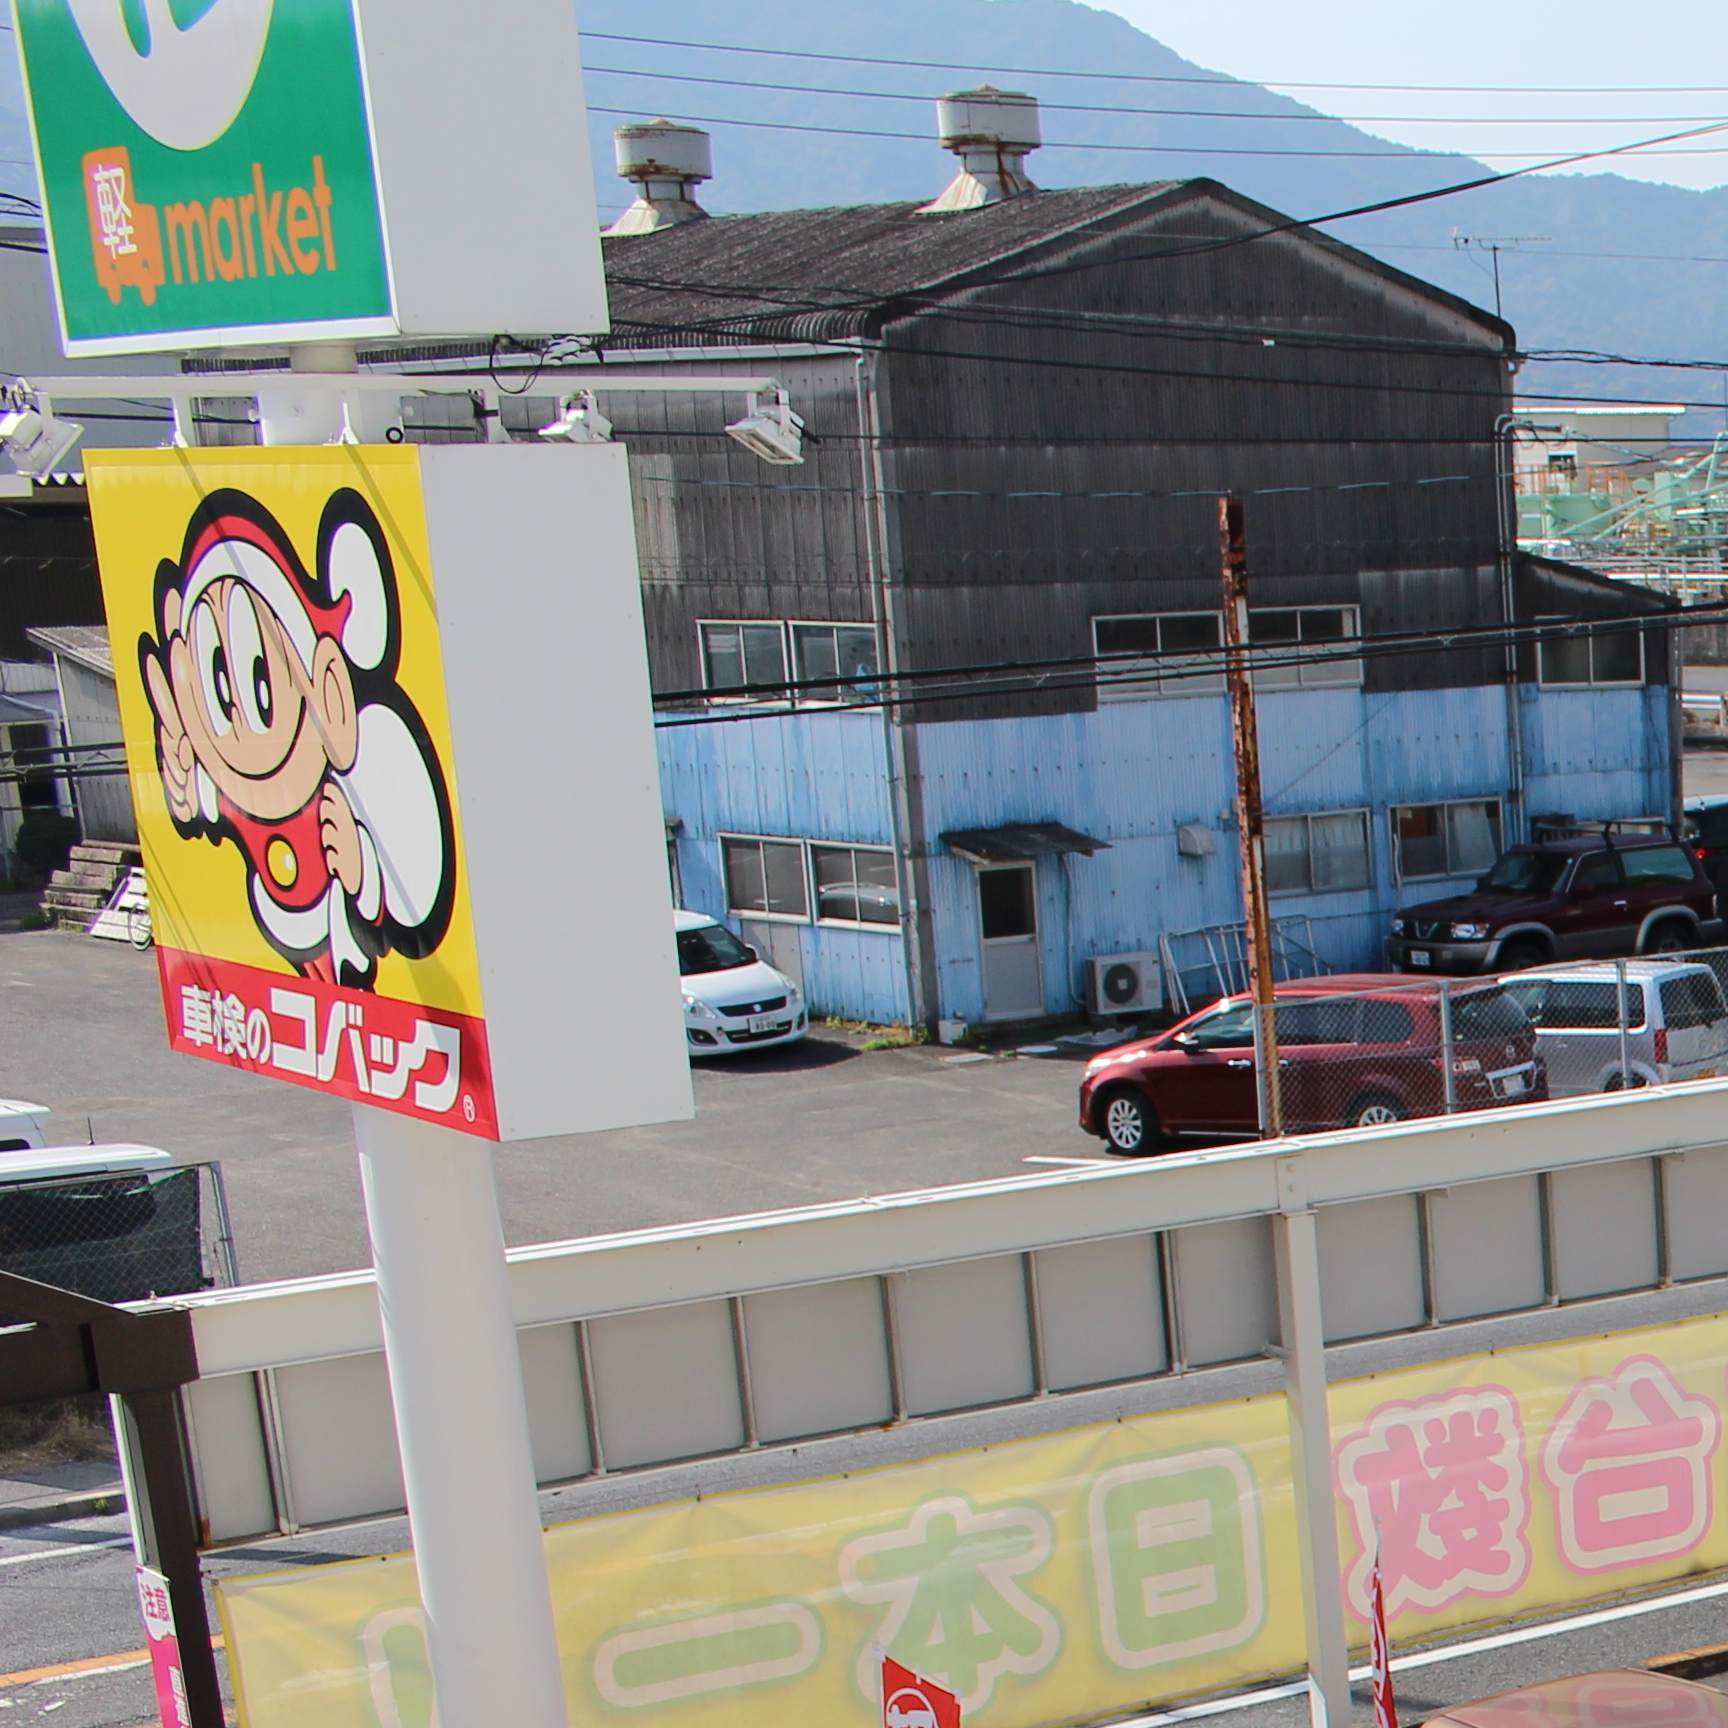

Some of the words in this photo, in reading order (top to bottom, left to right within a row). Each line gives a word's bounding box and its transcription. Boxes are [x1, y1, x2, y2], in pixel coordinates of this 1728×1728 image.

[93, 164, 137, 260] 軽
[164, 155, 337, 285] market
[181, 983, 463, 1113] 車検のコバック
[141, 1580, 173, 1625] 注意
